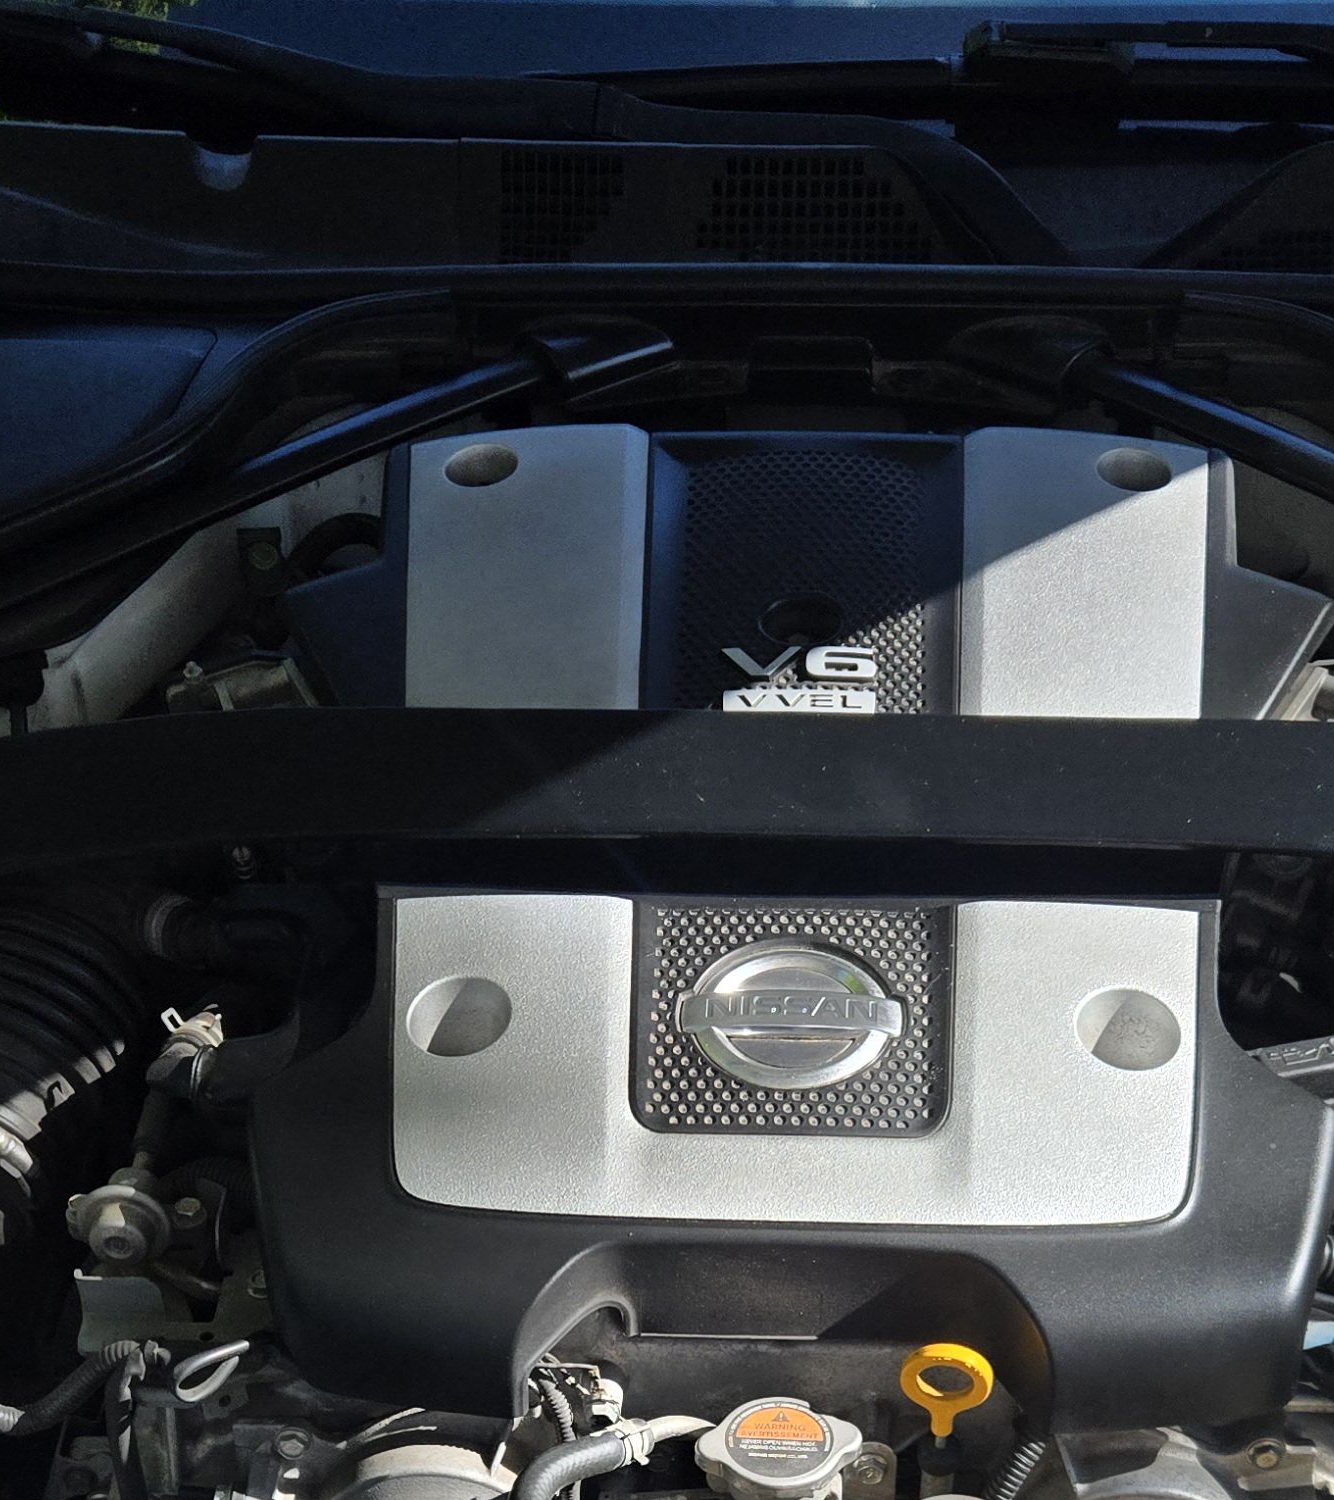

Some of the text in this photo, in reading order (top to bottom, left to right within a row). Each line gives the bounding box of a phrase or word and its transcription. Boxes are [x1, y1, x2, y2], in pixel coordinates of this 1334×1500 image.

[721, 645, 879, 682] V6
[736, 694, 864, 710] VVEL
[704, 994, 879, 1022] NISSAN
[741, 1430, 819, 1439] AVERTISSEMENT
[754, 1422, 806, 1431] WARNING
